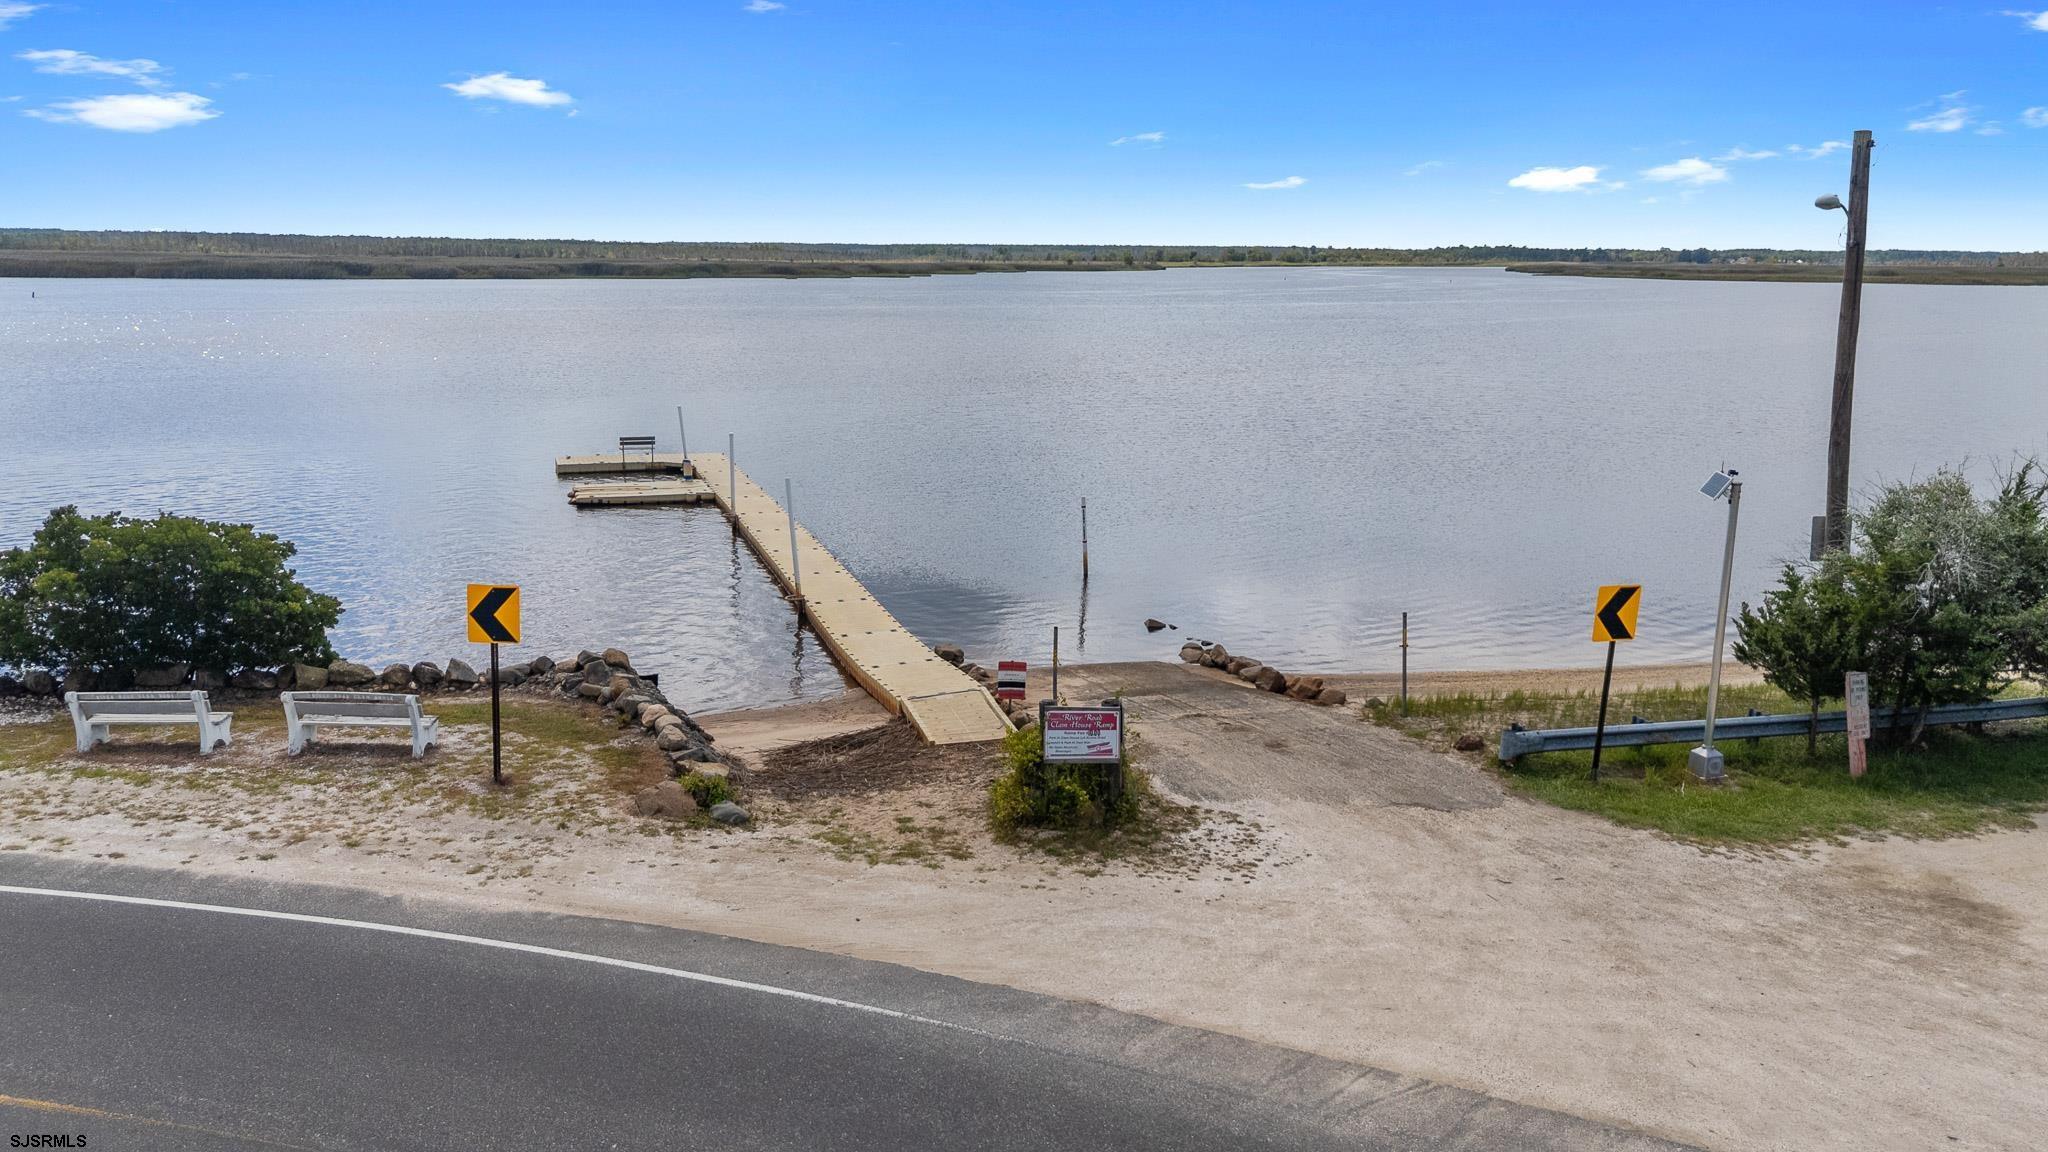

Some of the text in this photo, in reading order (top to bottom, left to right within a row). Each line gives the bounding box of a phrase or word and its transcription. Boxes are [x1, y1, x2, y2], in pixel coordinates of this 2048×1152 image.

[1062, 713, 1103, 721] River Road
[1069, 721, 1092, 729] House
[1094, 721, 1115, 730] Ramp
